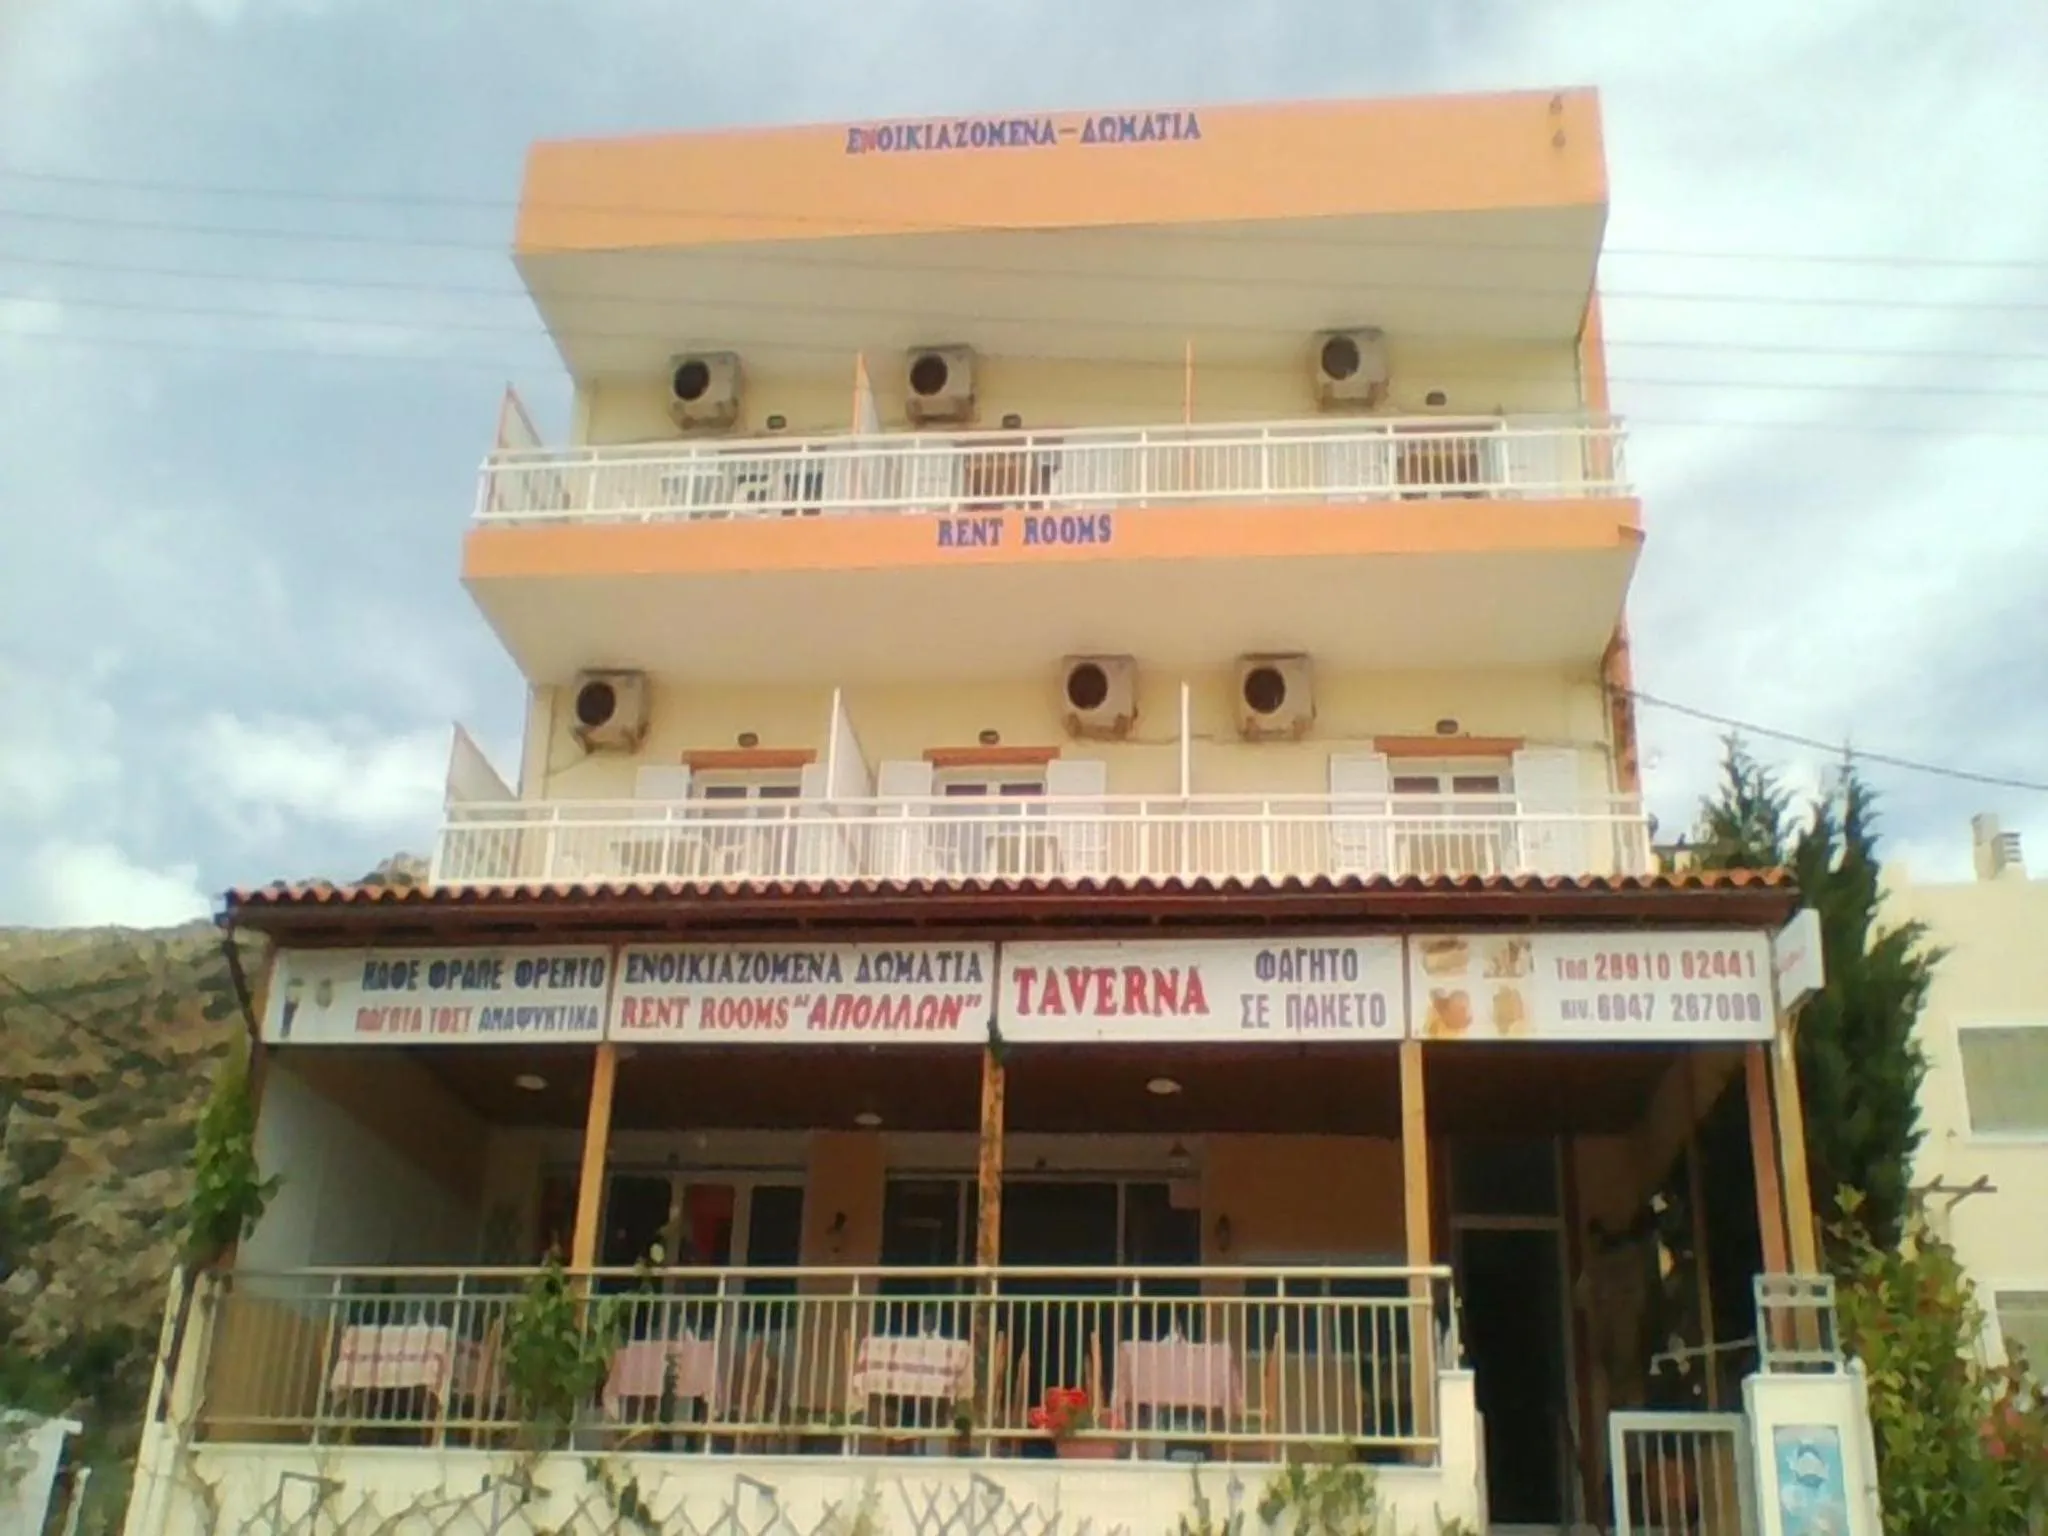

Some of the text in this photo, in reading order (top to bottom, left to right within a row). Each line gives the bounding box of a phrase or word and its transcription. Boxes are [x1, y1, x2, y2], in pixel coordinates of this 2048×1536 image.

[937, 513, 1112, 547] RENT ROOMS
[362, 960, 420, 991] ΚΑΦΕ
[625, 951, 983, 984] ΕΝΟΙΚΙΑΖΟΜΕΝΑ ΔΩΜΑΤΙΑ
[1255, 947, 1358, 983] ΦΑΓΗΤΟ
[1012, 965, 1210, 1017] TAVERNA
[620, 995, 690, 1029] RENT
[698, 996, 788, 1030] ROOMS
[1241, 992, 1387, 1029] ΣΕ ΠΑΚΕΤΟ
